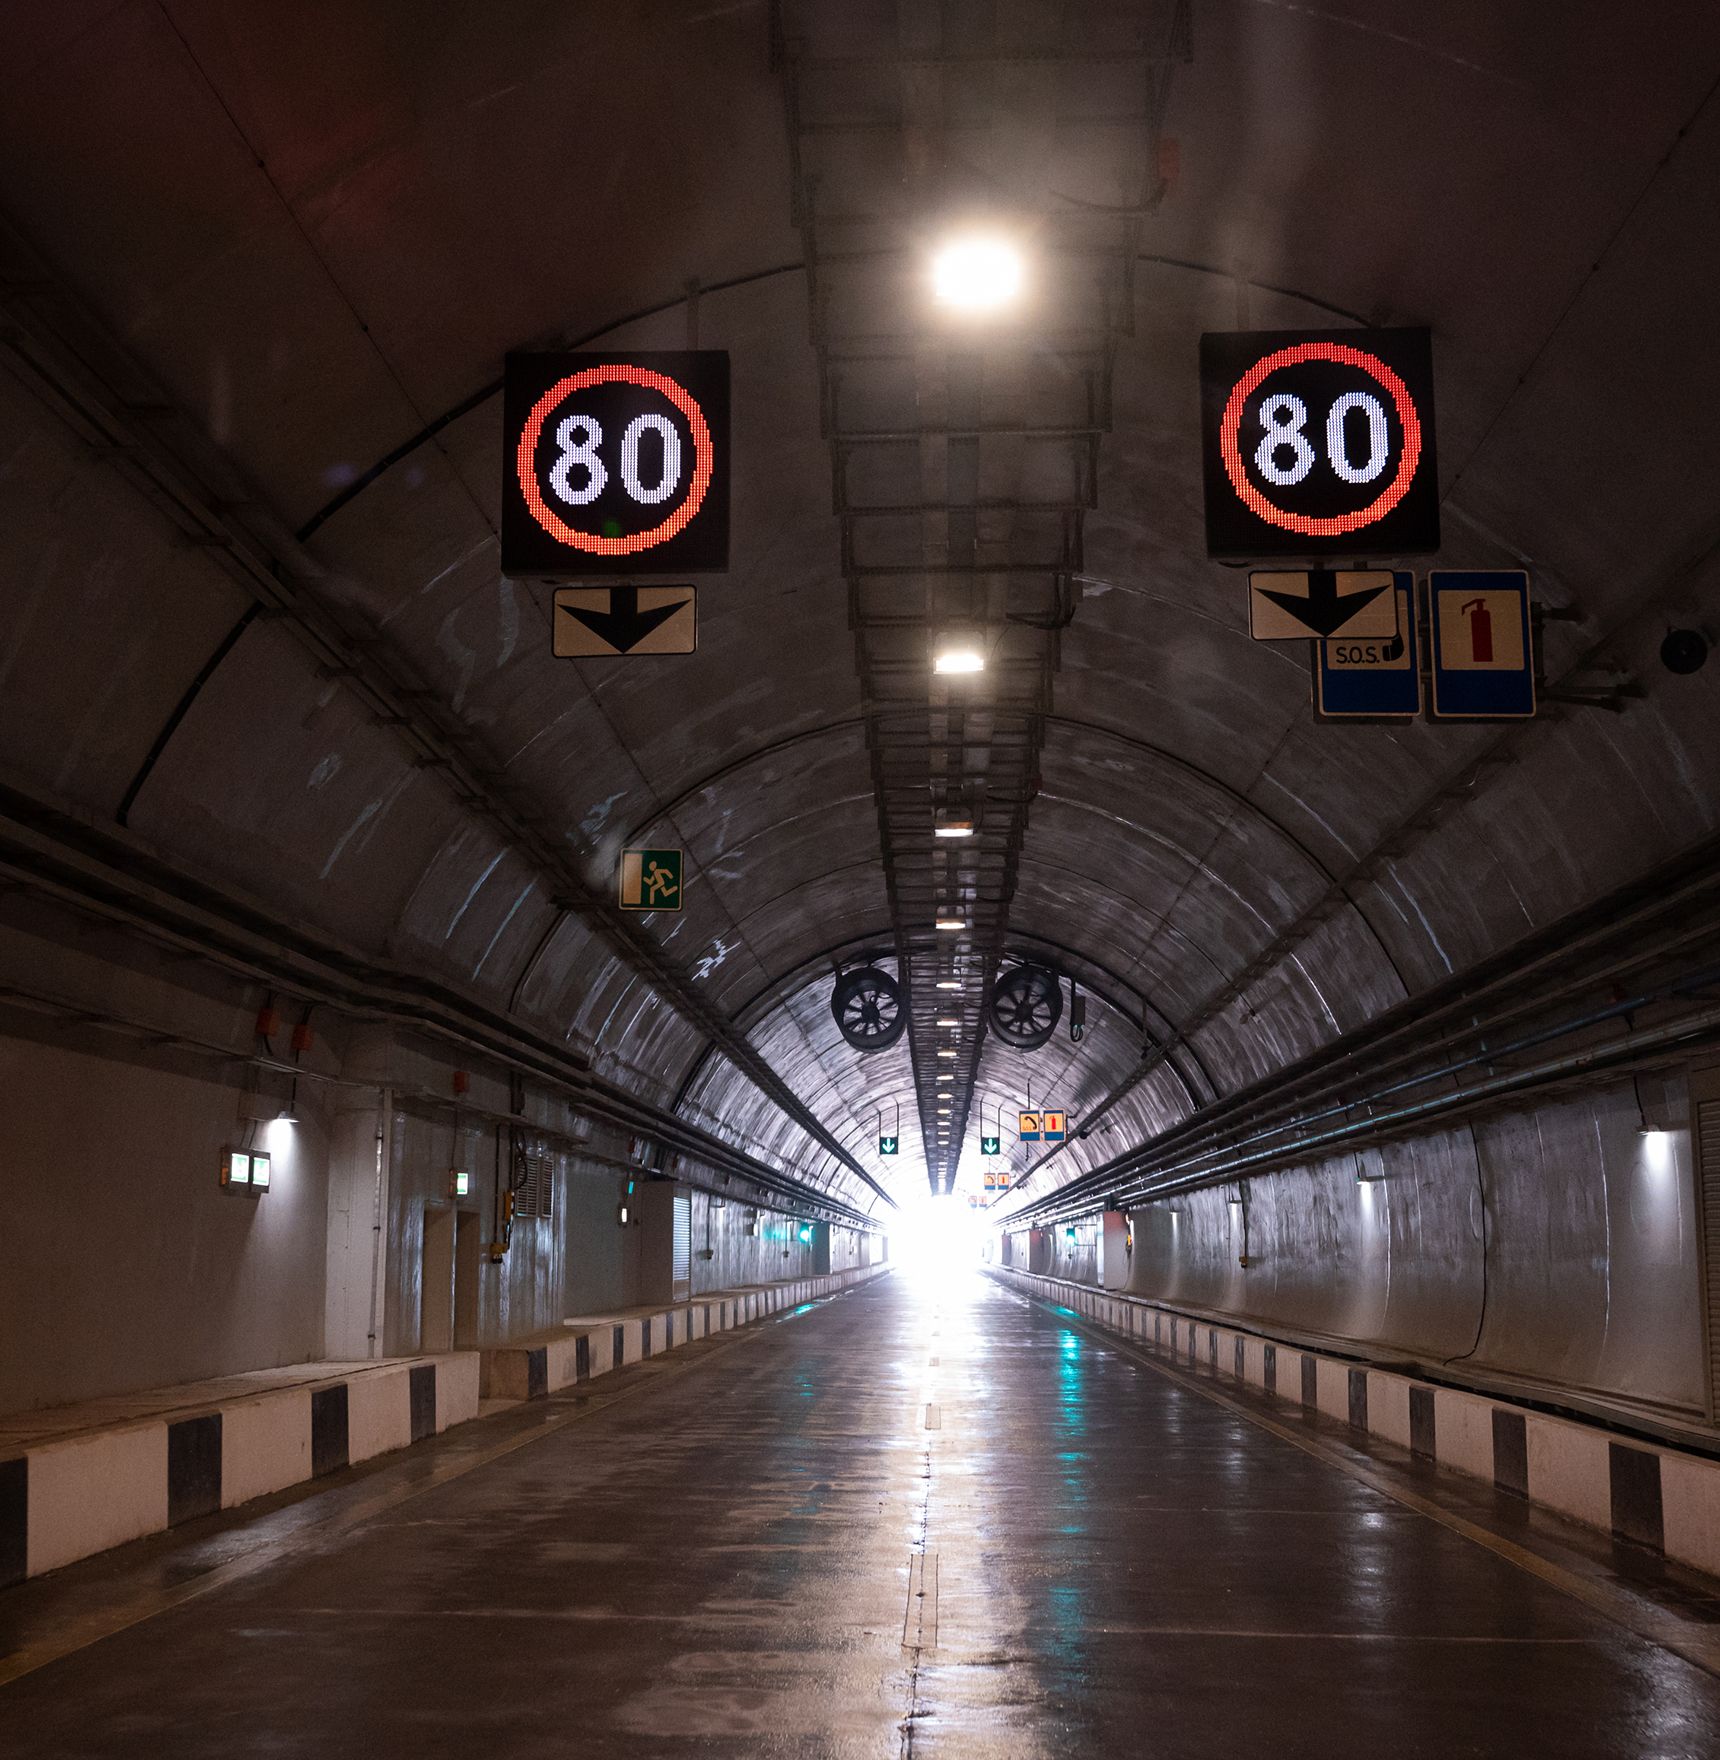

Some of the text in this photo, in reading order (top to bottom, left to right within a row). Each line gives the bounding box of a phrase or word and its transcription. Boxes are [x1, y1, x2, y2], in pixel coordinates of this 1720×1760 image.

[549, 414, 682, 505] 80
[1254, 391, 1389, 486] 80
[1335, 646, 1380, 664] S.O.S.
